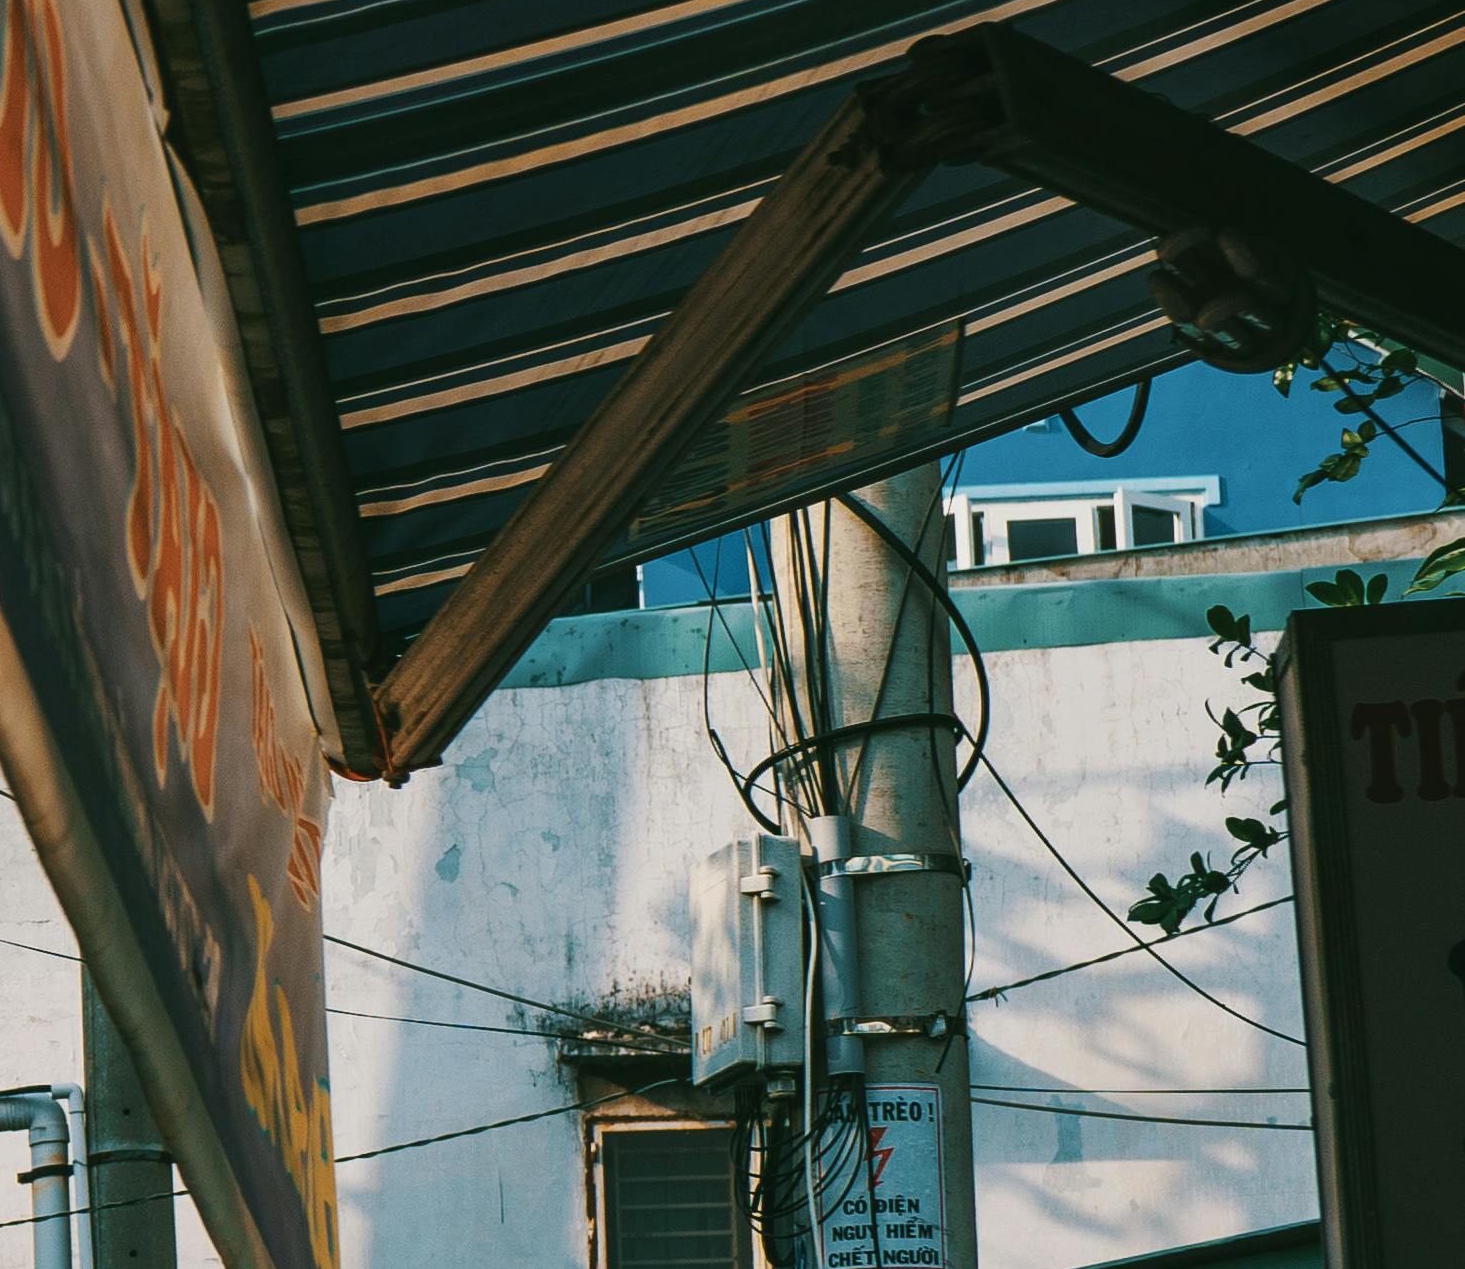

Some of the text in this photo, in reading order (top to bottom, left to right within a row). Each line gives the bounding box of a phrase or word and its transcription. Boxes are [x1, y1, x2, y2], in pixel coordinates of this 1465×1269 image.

[843, 1195, 920, 1216] CÓ ĐIỆN
[832, 1216, 934, 1242] NGUY HIỂM
[828, 1245, 940, 1268] CHẾT NGƯỜI
